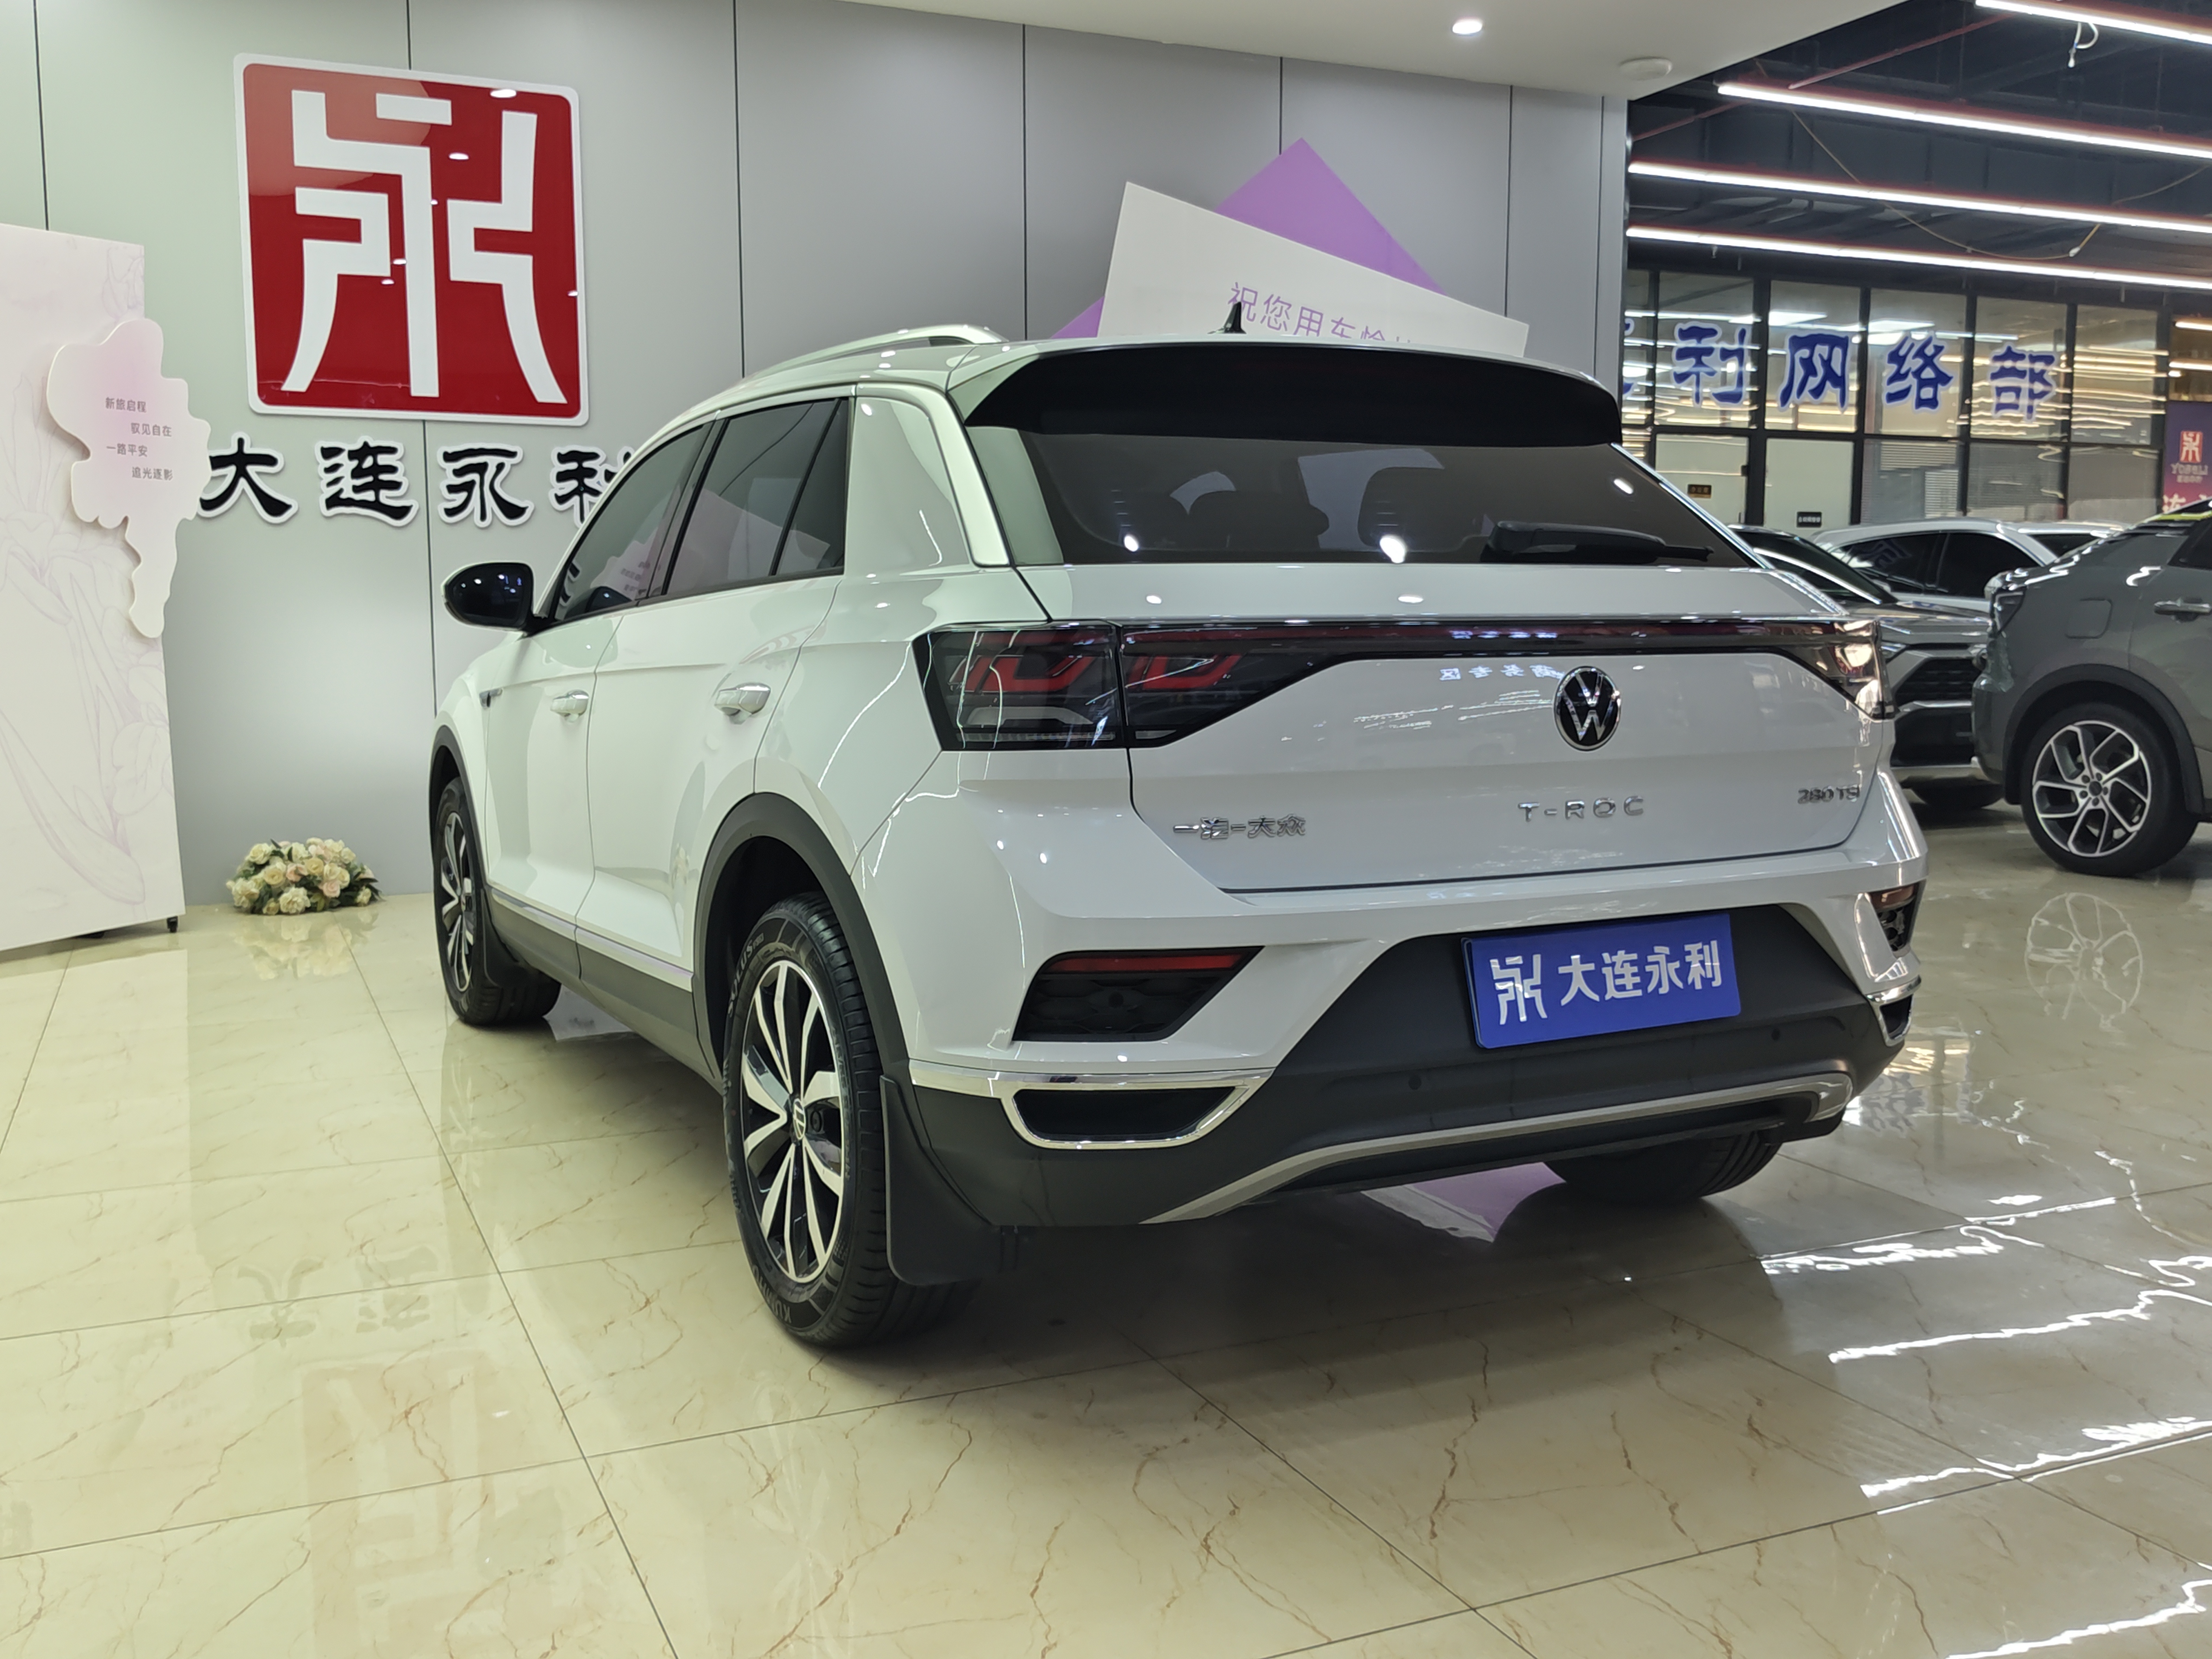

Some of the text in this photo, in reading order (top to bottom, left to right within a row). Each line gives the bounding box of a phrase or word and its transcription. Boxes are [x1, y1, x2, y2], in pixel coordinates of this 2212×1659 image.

[1228, 282, 1411, 343] 祝您用车
[1624, 323, 2055, 420] 利网络部
[106, 397, 146, 413] 新旅启程
[131, 422, 172, 437] 驭见自在
[106, 443, 148, 457] 一路平安
[1517, 795, 1644, 822] T-ROC
[1558, 940, 1722, 1006] 大连永利
